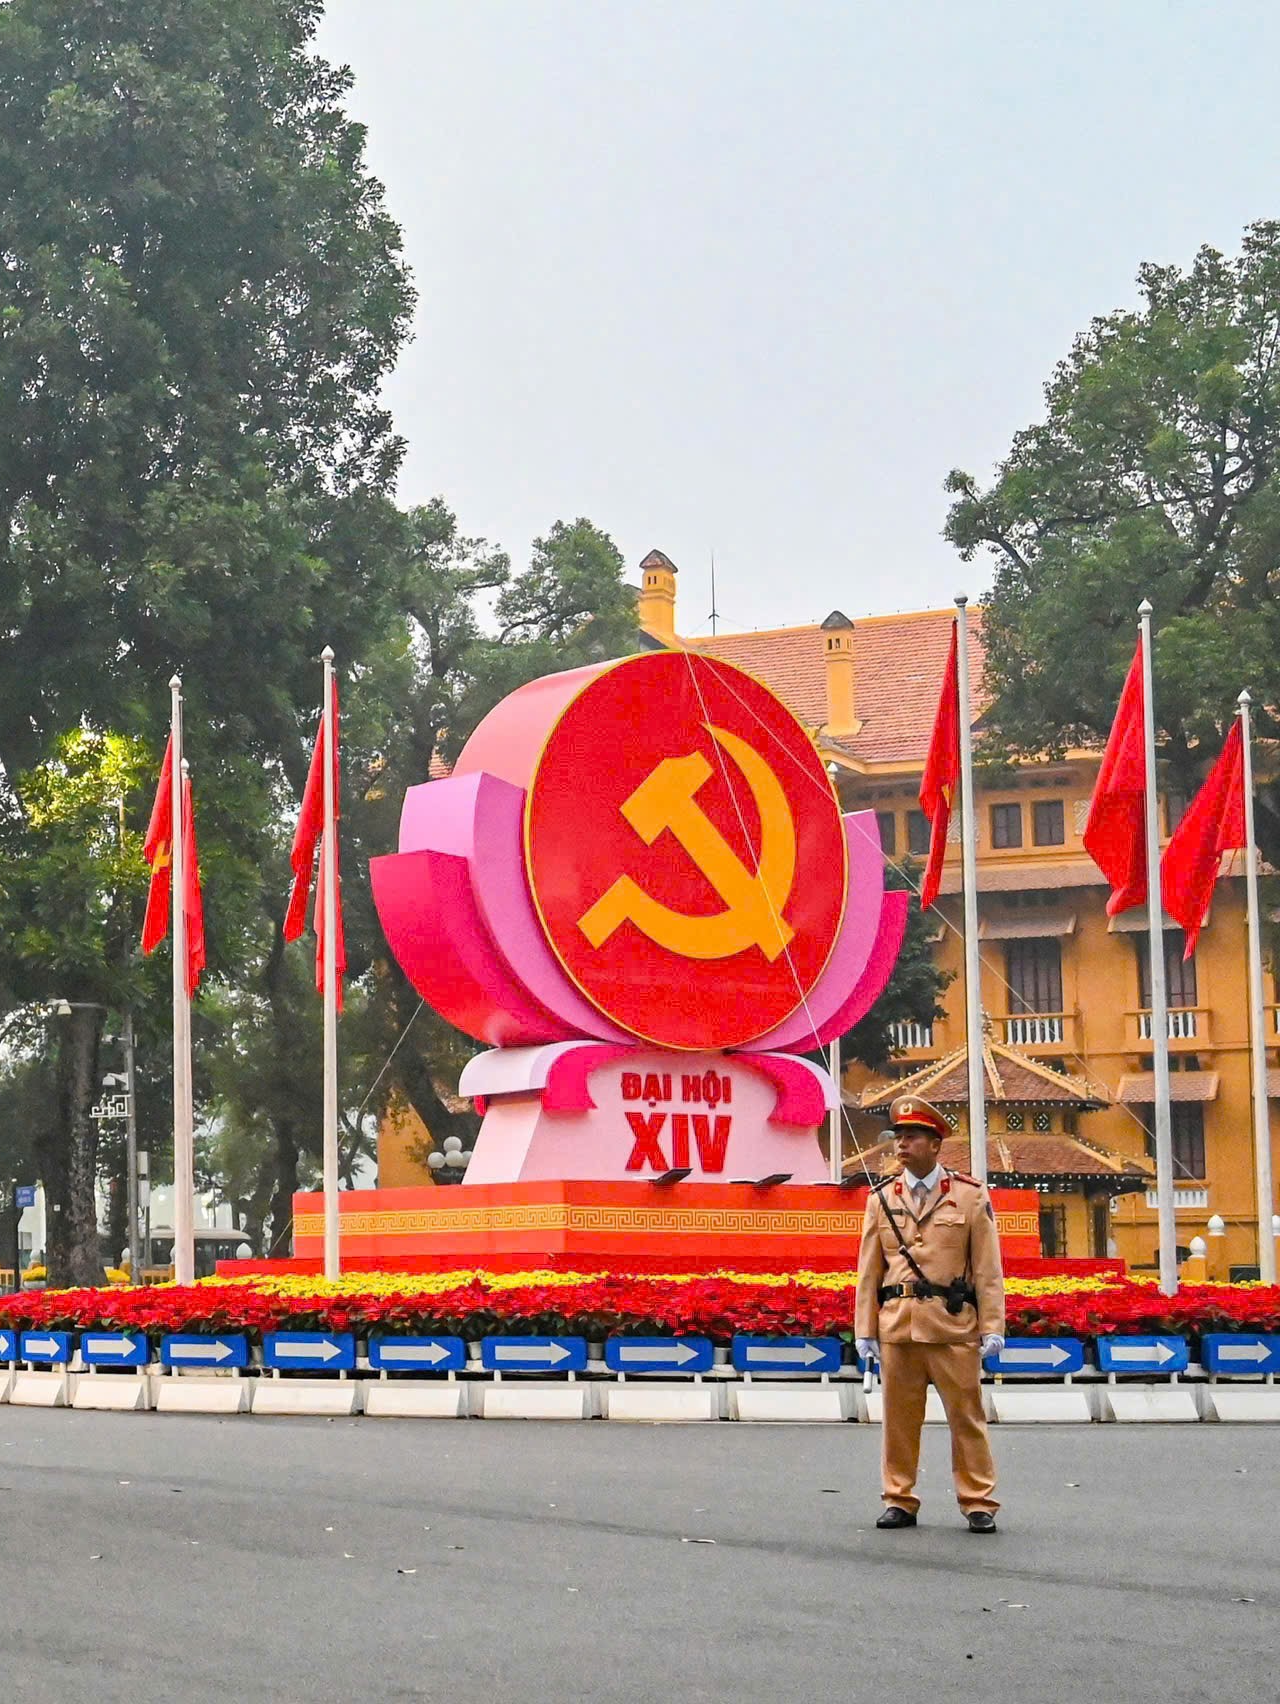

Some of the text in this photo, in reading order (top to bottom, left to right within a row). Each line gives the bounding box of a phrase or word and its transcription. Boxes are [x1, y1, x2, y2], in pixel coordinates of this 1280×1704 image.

[621, 1070, 732, 1109] ĐẠI HỘI
[624, 1112, 732, 1174] XIV
